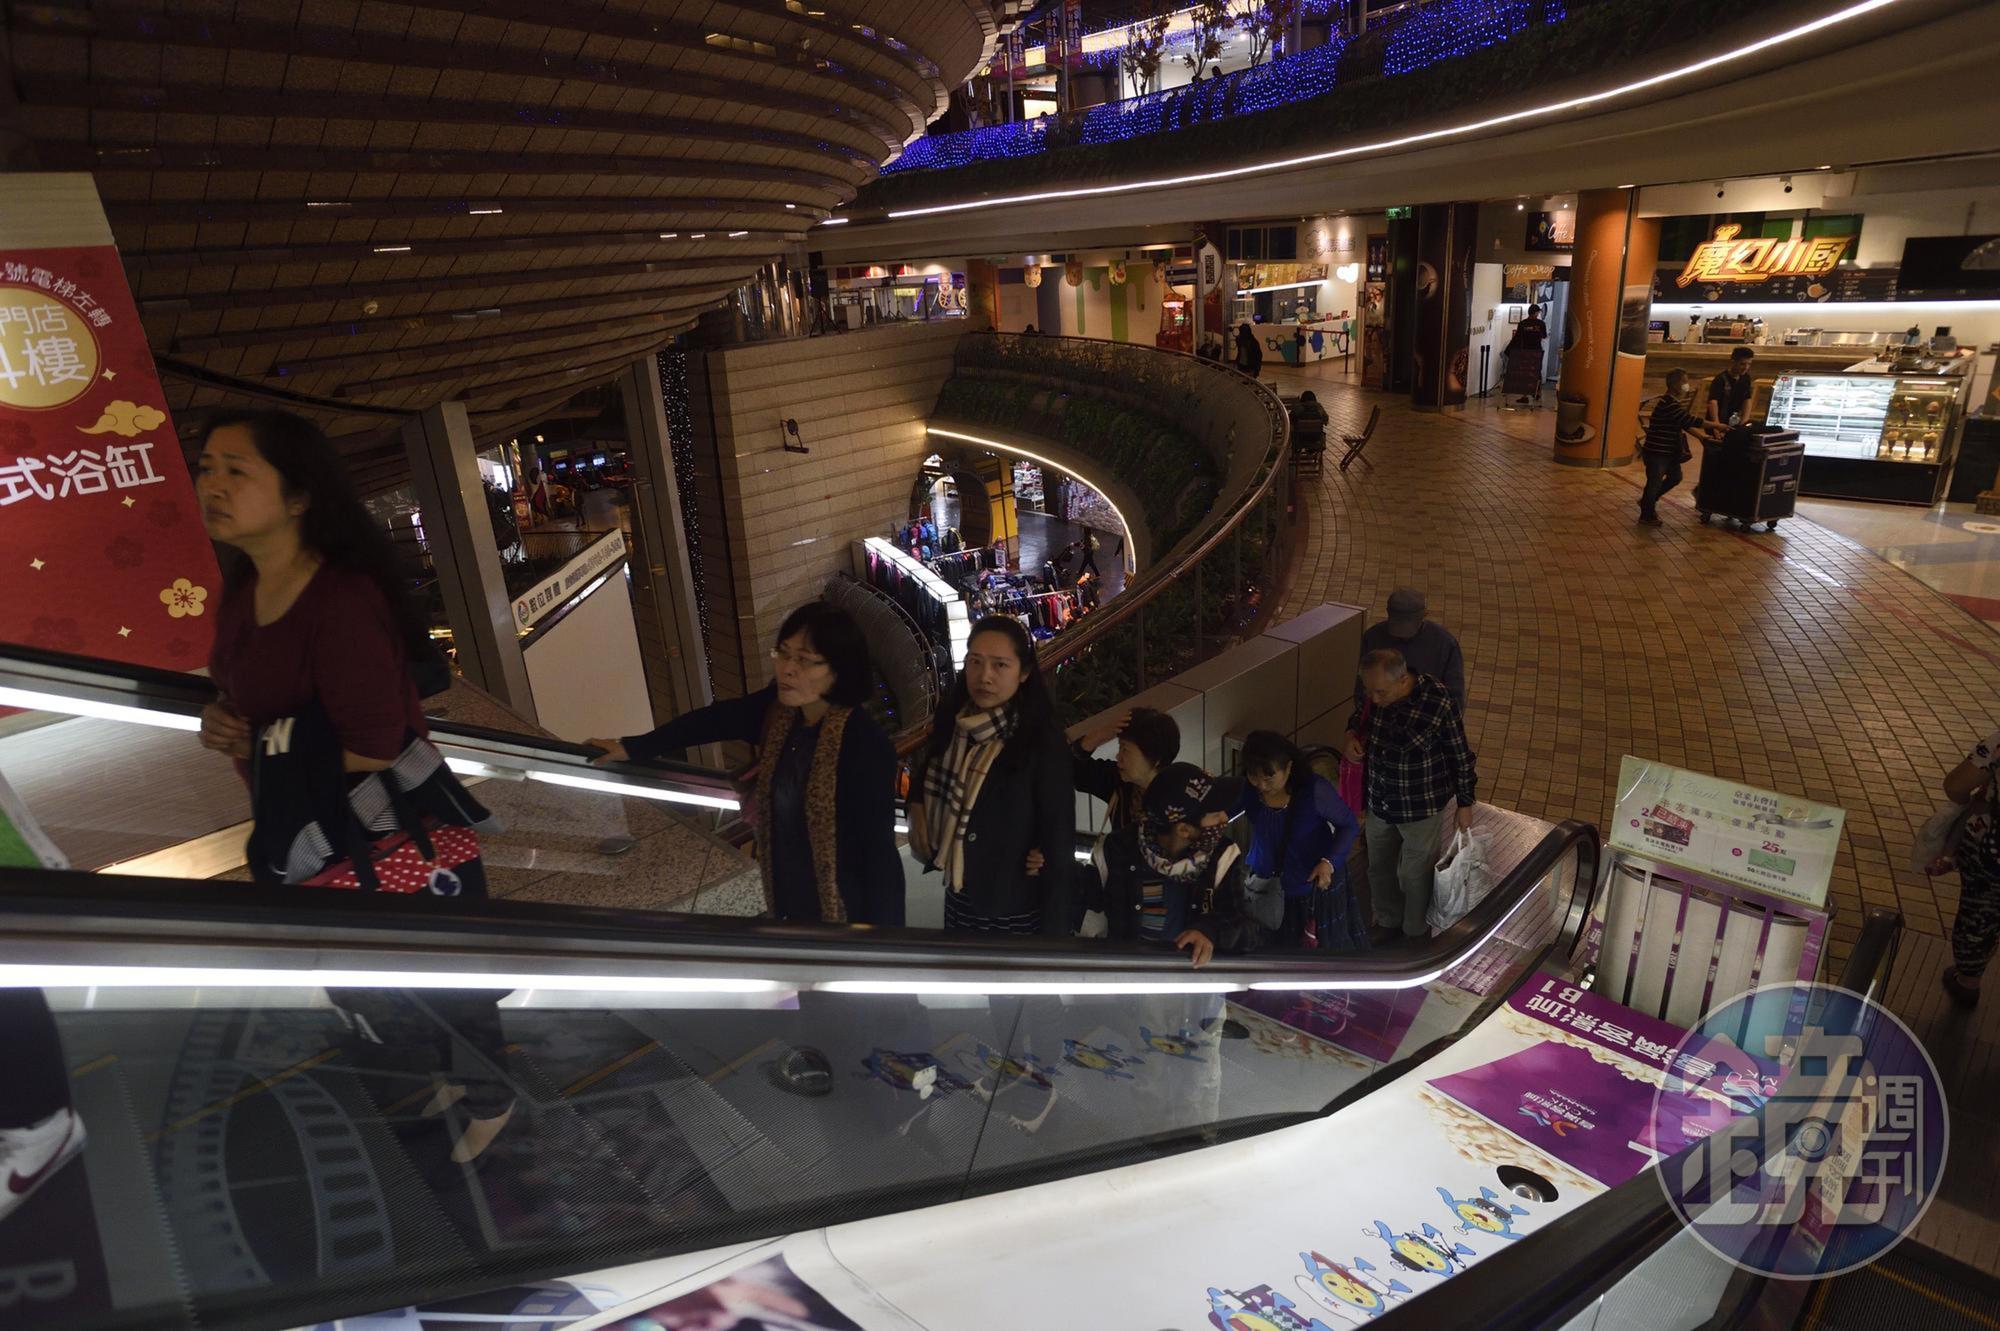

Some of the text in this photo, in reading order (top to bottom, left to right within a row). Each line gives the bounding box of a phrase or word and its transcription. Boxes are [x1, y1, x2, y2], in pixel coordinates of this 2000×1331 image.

[0, 261, 113, 328] 號電梯左轉
[1540, 979, 1584, 1004] B1
